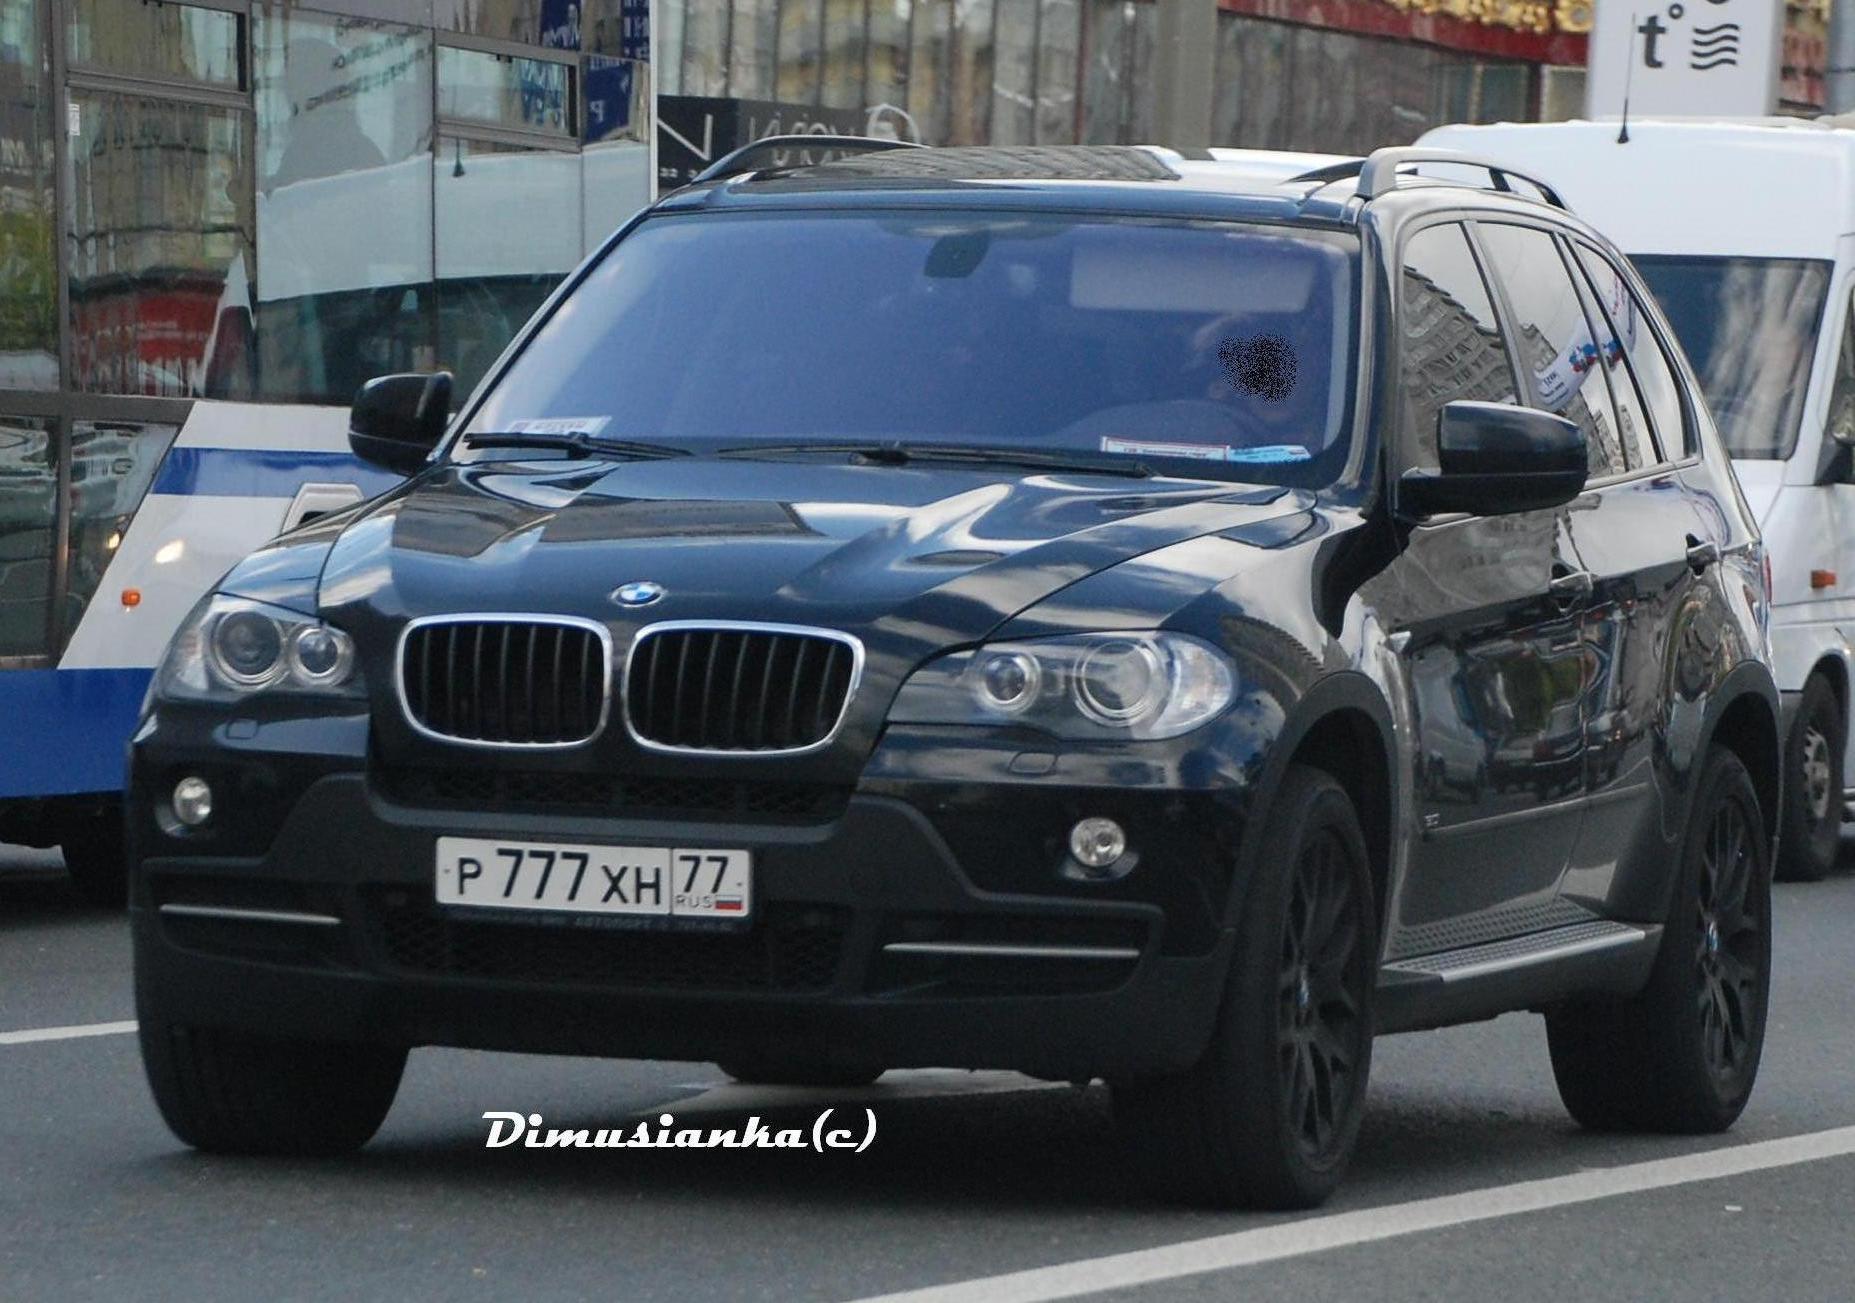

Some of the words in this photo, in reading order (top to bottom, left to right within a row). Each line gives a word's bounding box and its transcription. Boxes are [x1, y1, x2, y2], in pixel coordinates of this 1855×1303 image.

[496, 848, 590, 902] 777
[679, 855, 729, 894] 77
[674, 894, 713, 909] RUS
